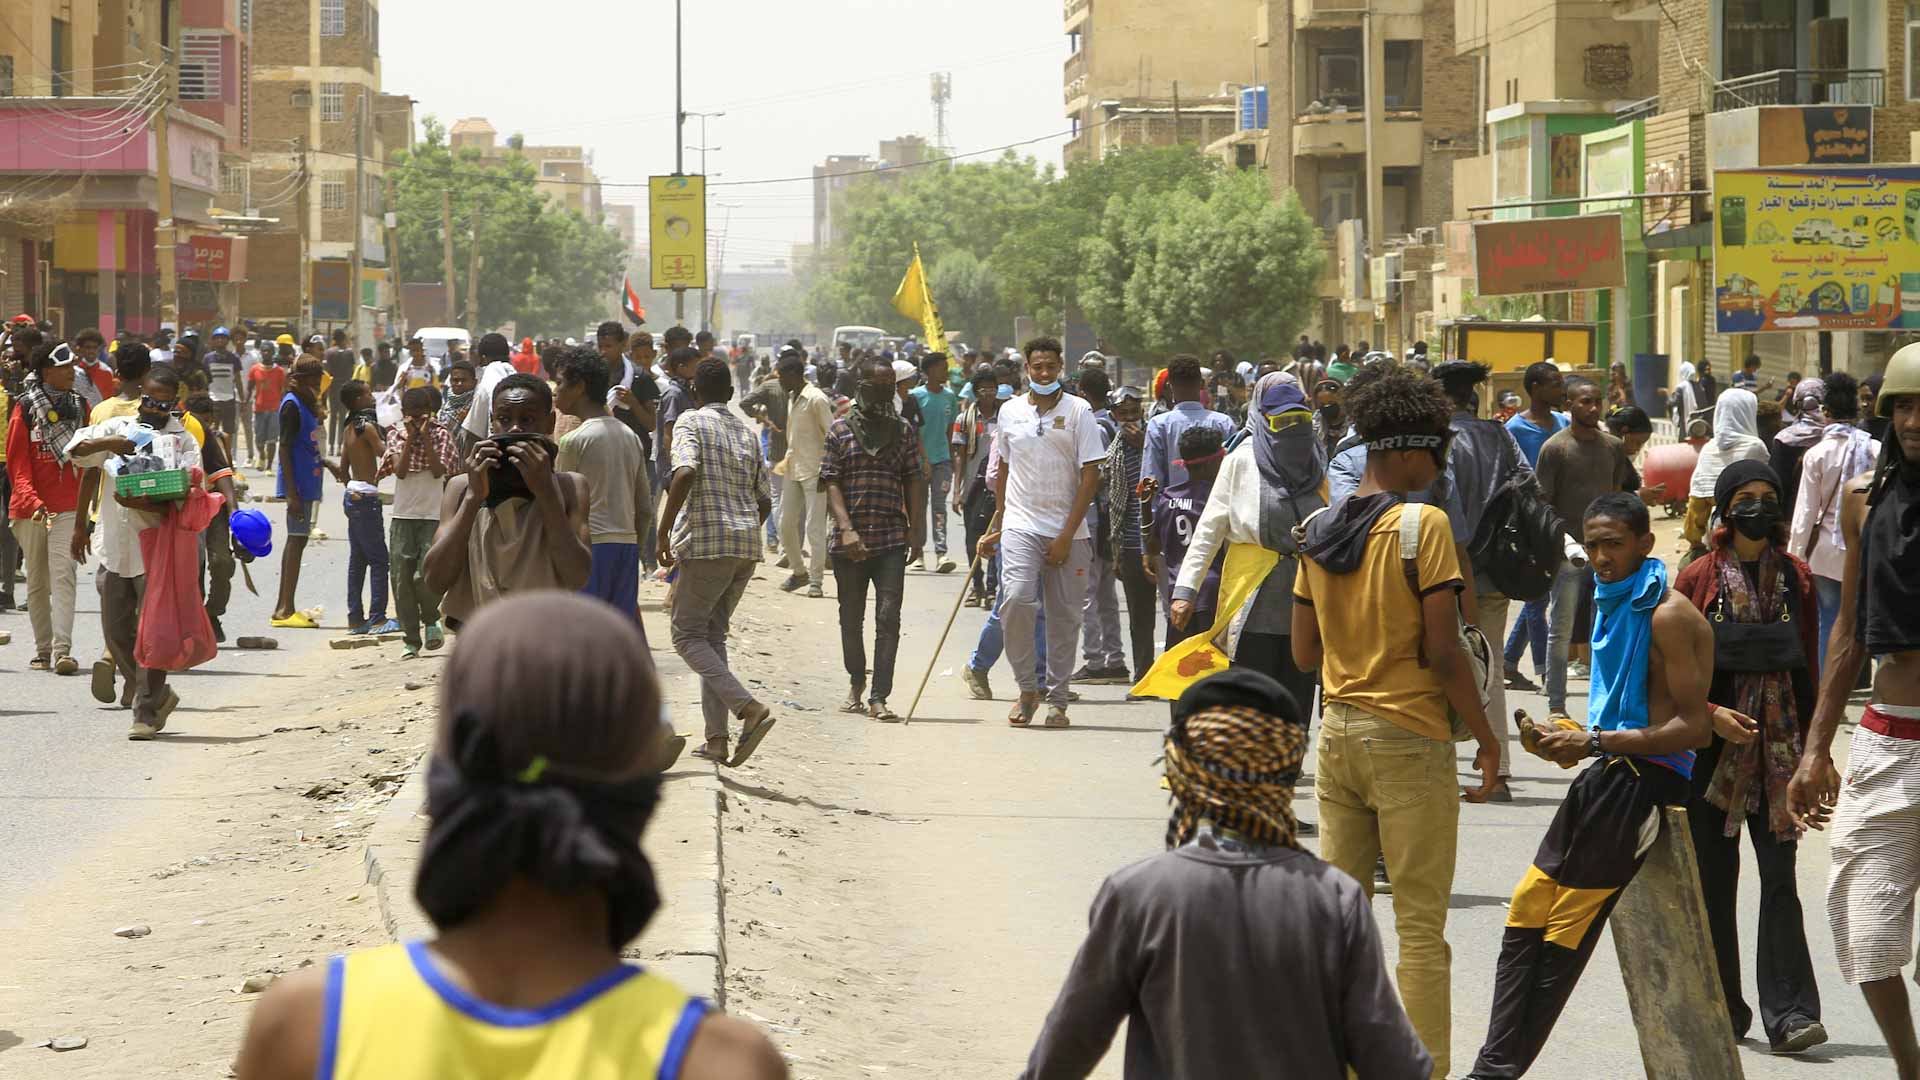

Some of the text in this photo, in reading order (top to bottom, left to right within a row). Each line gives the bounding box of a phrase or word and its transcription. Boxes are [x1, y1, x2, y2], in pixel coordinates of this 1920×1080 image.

[1767, 174, 1889, 192] مركز المدينة
[1175, 514, 1193, 547] 9
